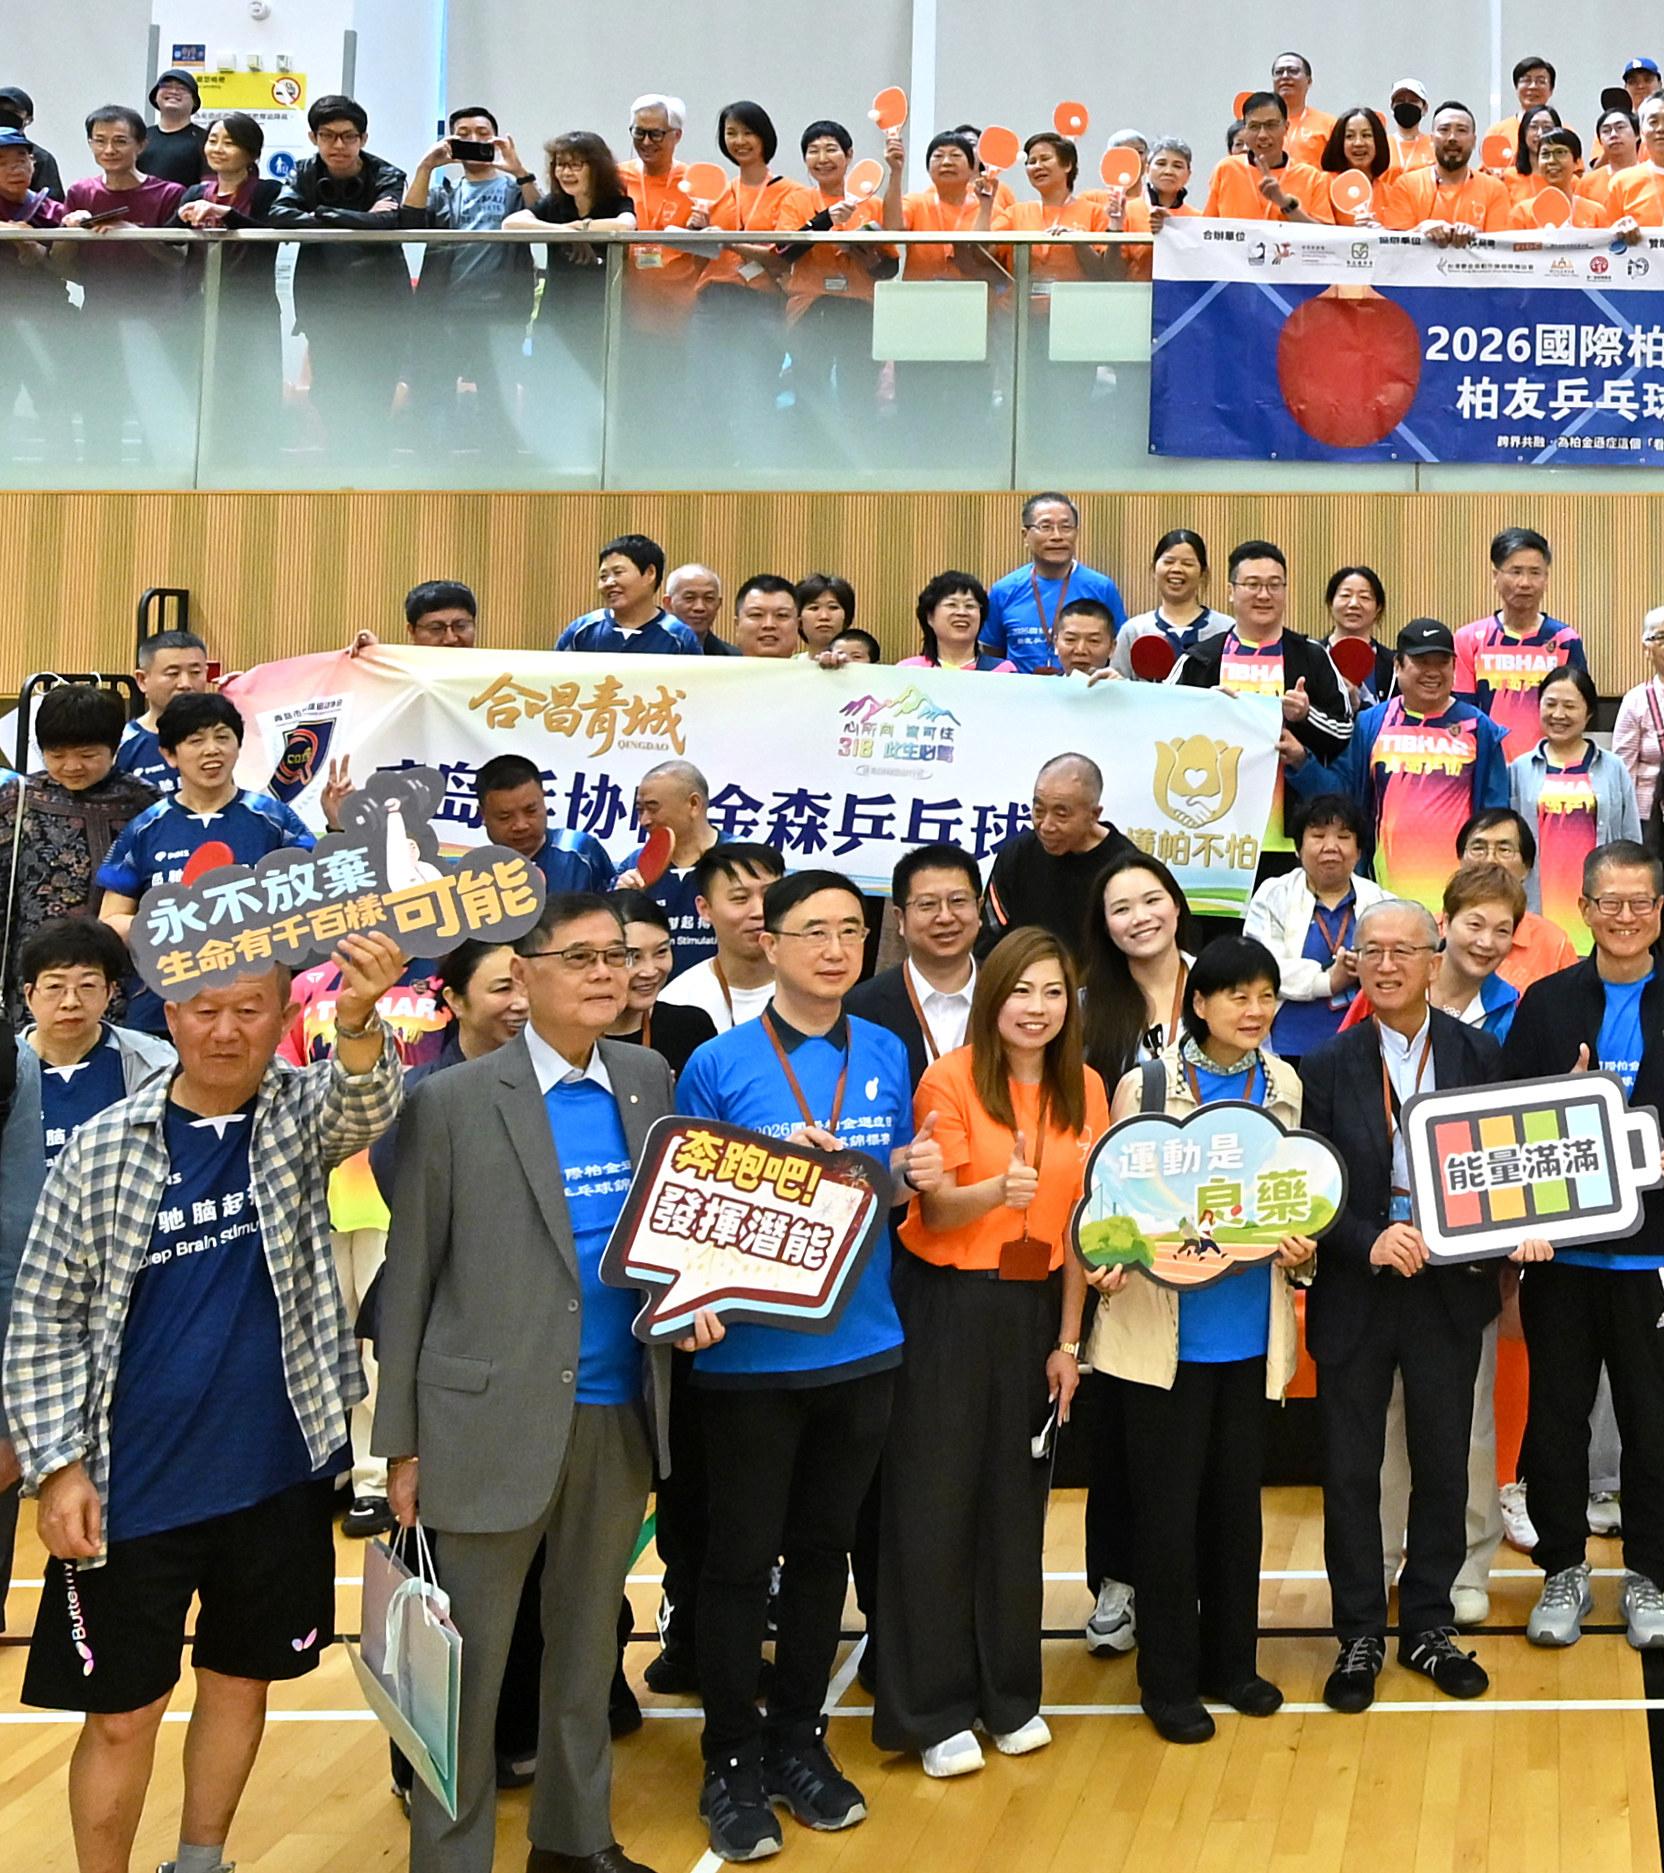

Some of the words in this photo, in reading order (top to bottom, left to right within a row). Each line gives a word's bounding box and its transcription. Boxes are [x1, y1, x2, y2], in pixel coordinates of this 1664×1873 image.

[468, 672, 688, 758] 合唱青城
[617, 739, 670, 752] QINGDAO
[838, 737, 874, 758] 318
[1378, 734, 1470, 756] TIBHAR
[147, 846, 377, 947] 永不放棄
[1119, 1132, 1245, 1179] 運動是
[1447, 1138, 1600, 1191] 能量滿滿
[1195, 1168, 1312, 1228] 良藥
[175, 1234, 217, 1257] Brain
[649, 1183, 834, 1270] 發揮潛能
